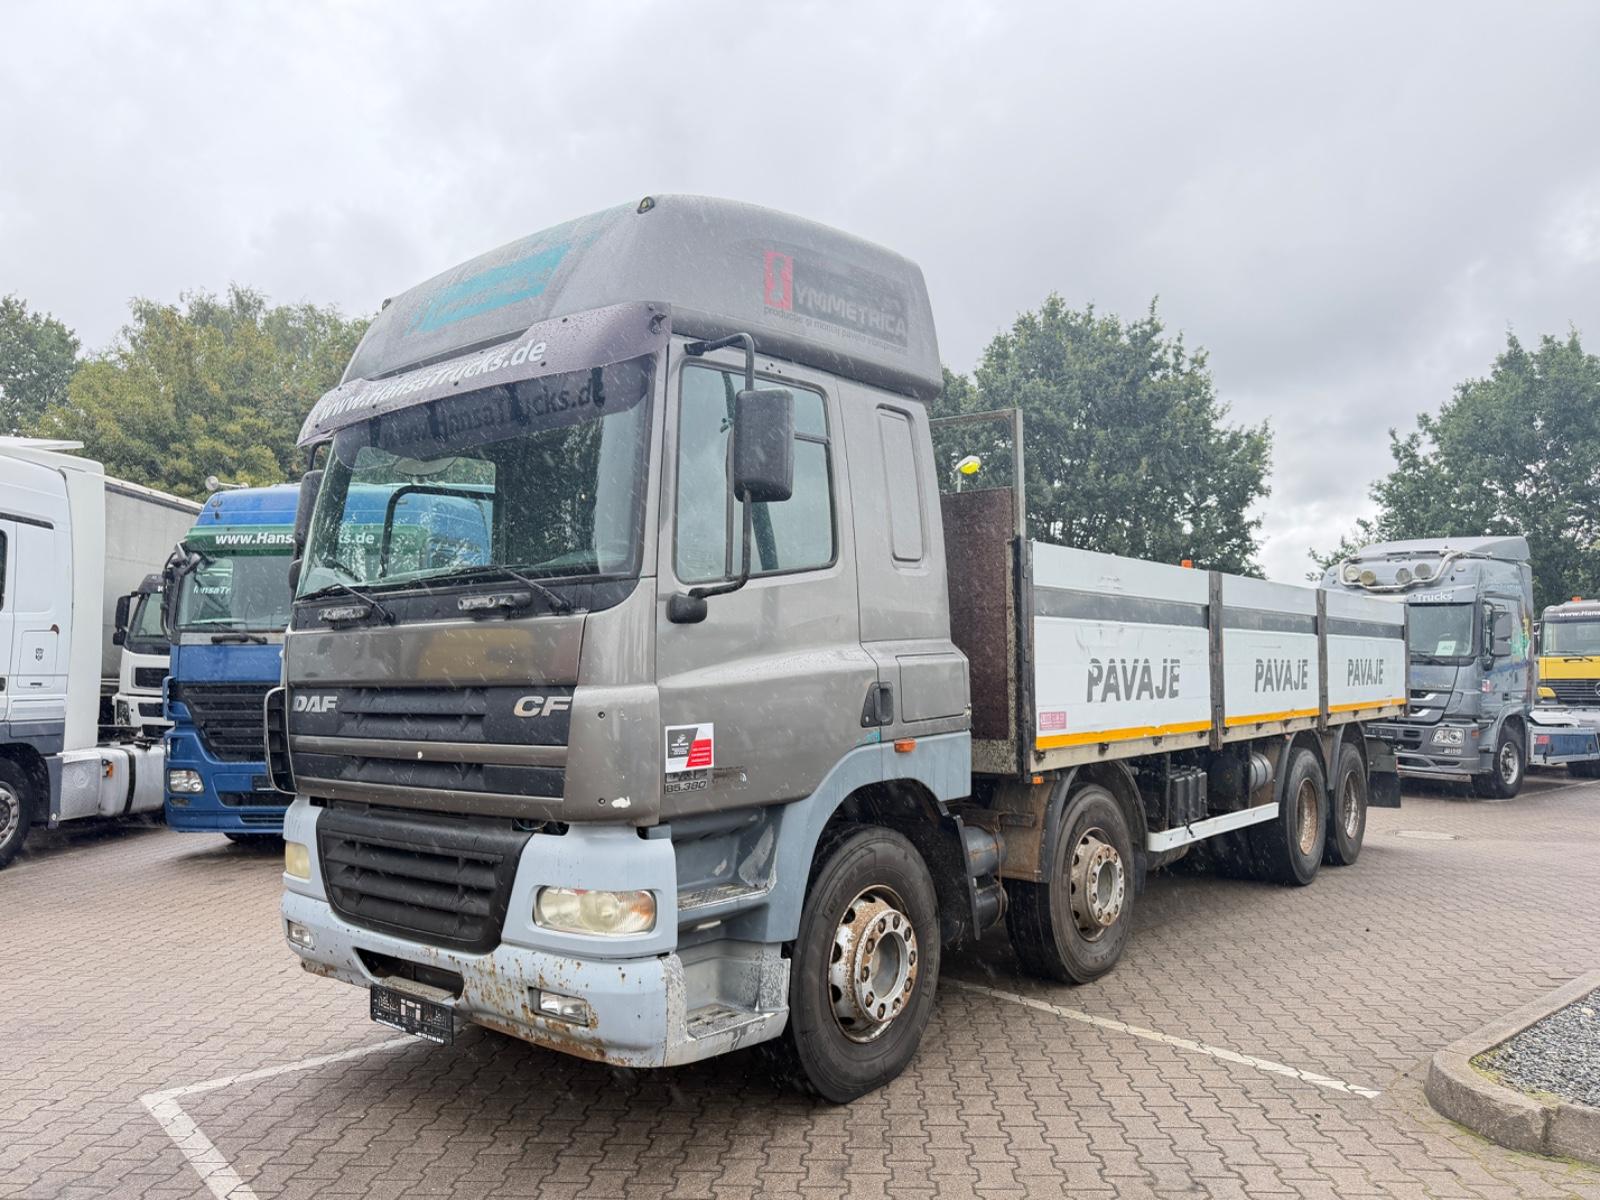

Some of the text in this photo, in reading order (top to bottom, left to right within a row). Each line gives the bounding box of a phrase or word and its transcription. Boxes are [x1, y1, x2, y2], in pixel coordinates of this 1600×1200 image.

[1086, 657, 1181, 703] PAVAJE
[1255, 658, 1308, 693] PAVAJE
[1347, 658, 1384, 687] PAVAJE
[293, 695, 338, 713] DAF
[513, 696, 573, 717] CF
